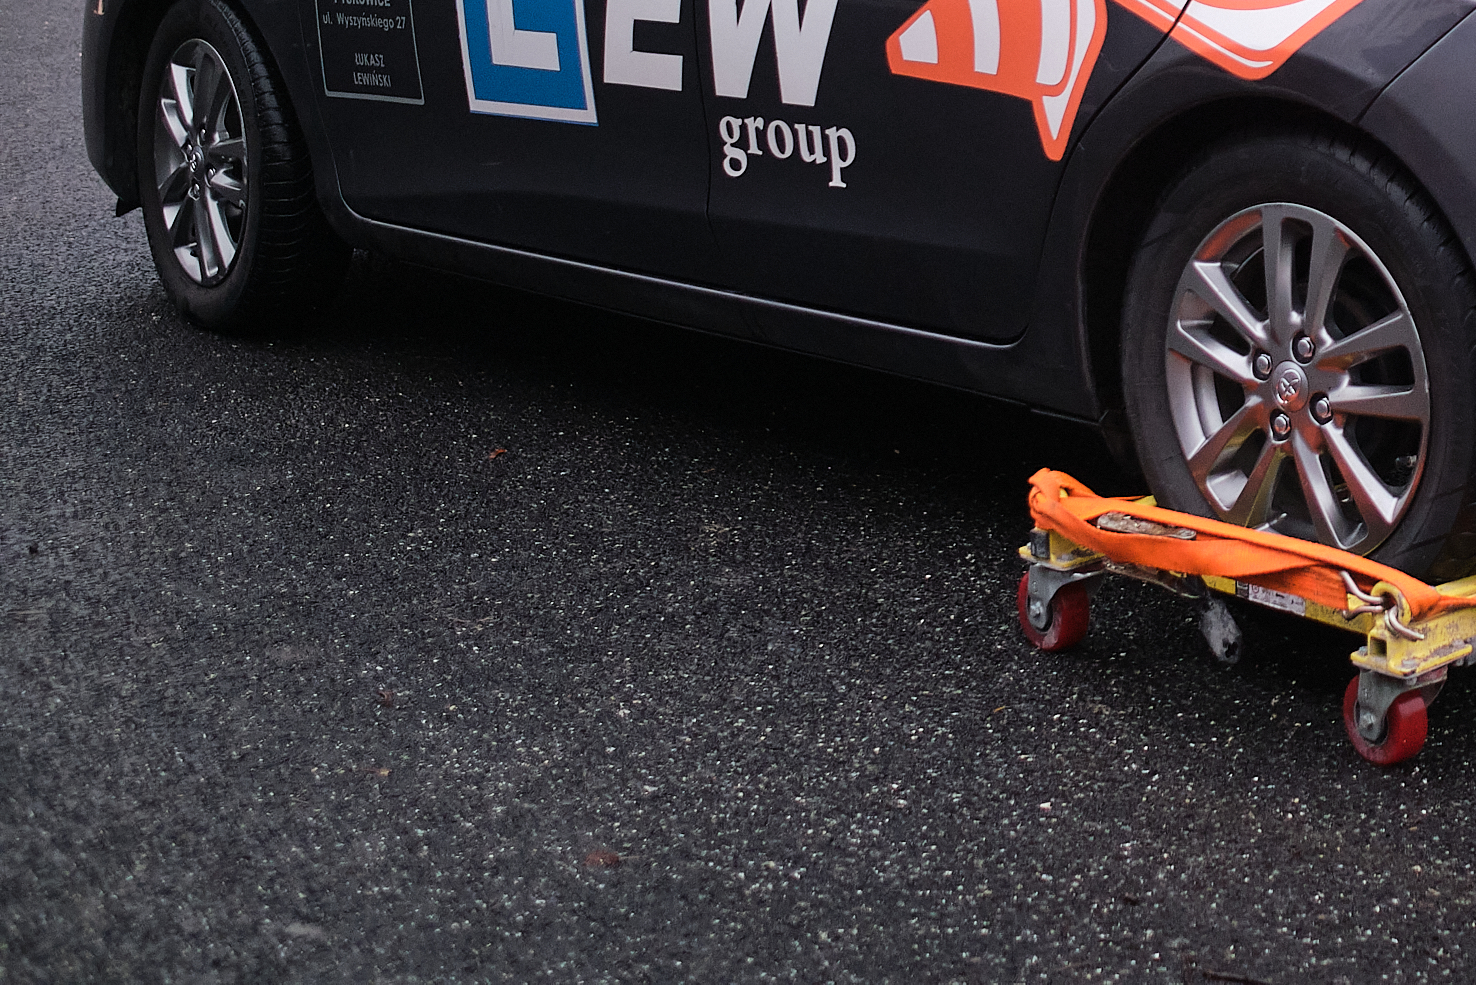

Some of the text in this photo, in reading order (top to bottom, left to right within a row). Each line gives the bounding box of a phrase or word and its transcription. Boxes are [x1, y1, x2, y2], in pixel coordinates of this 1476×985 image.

[322, 11, 406, 31] ul. Wyszyńskiego 27
[354, 52, 386, 68] ŁUKASZ
[353, 70, 392, 88] LEWIŃSKI
[718, 115, 858, 189] group
